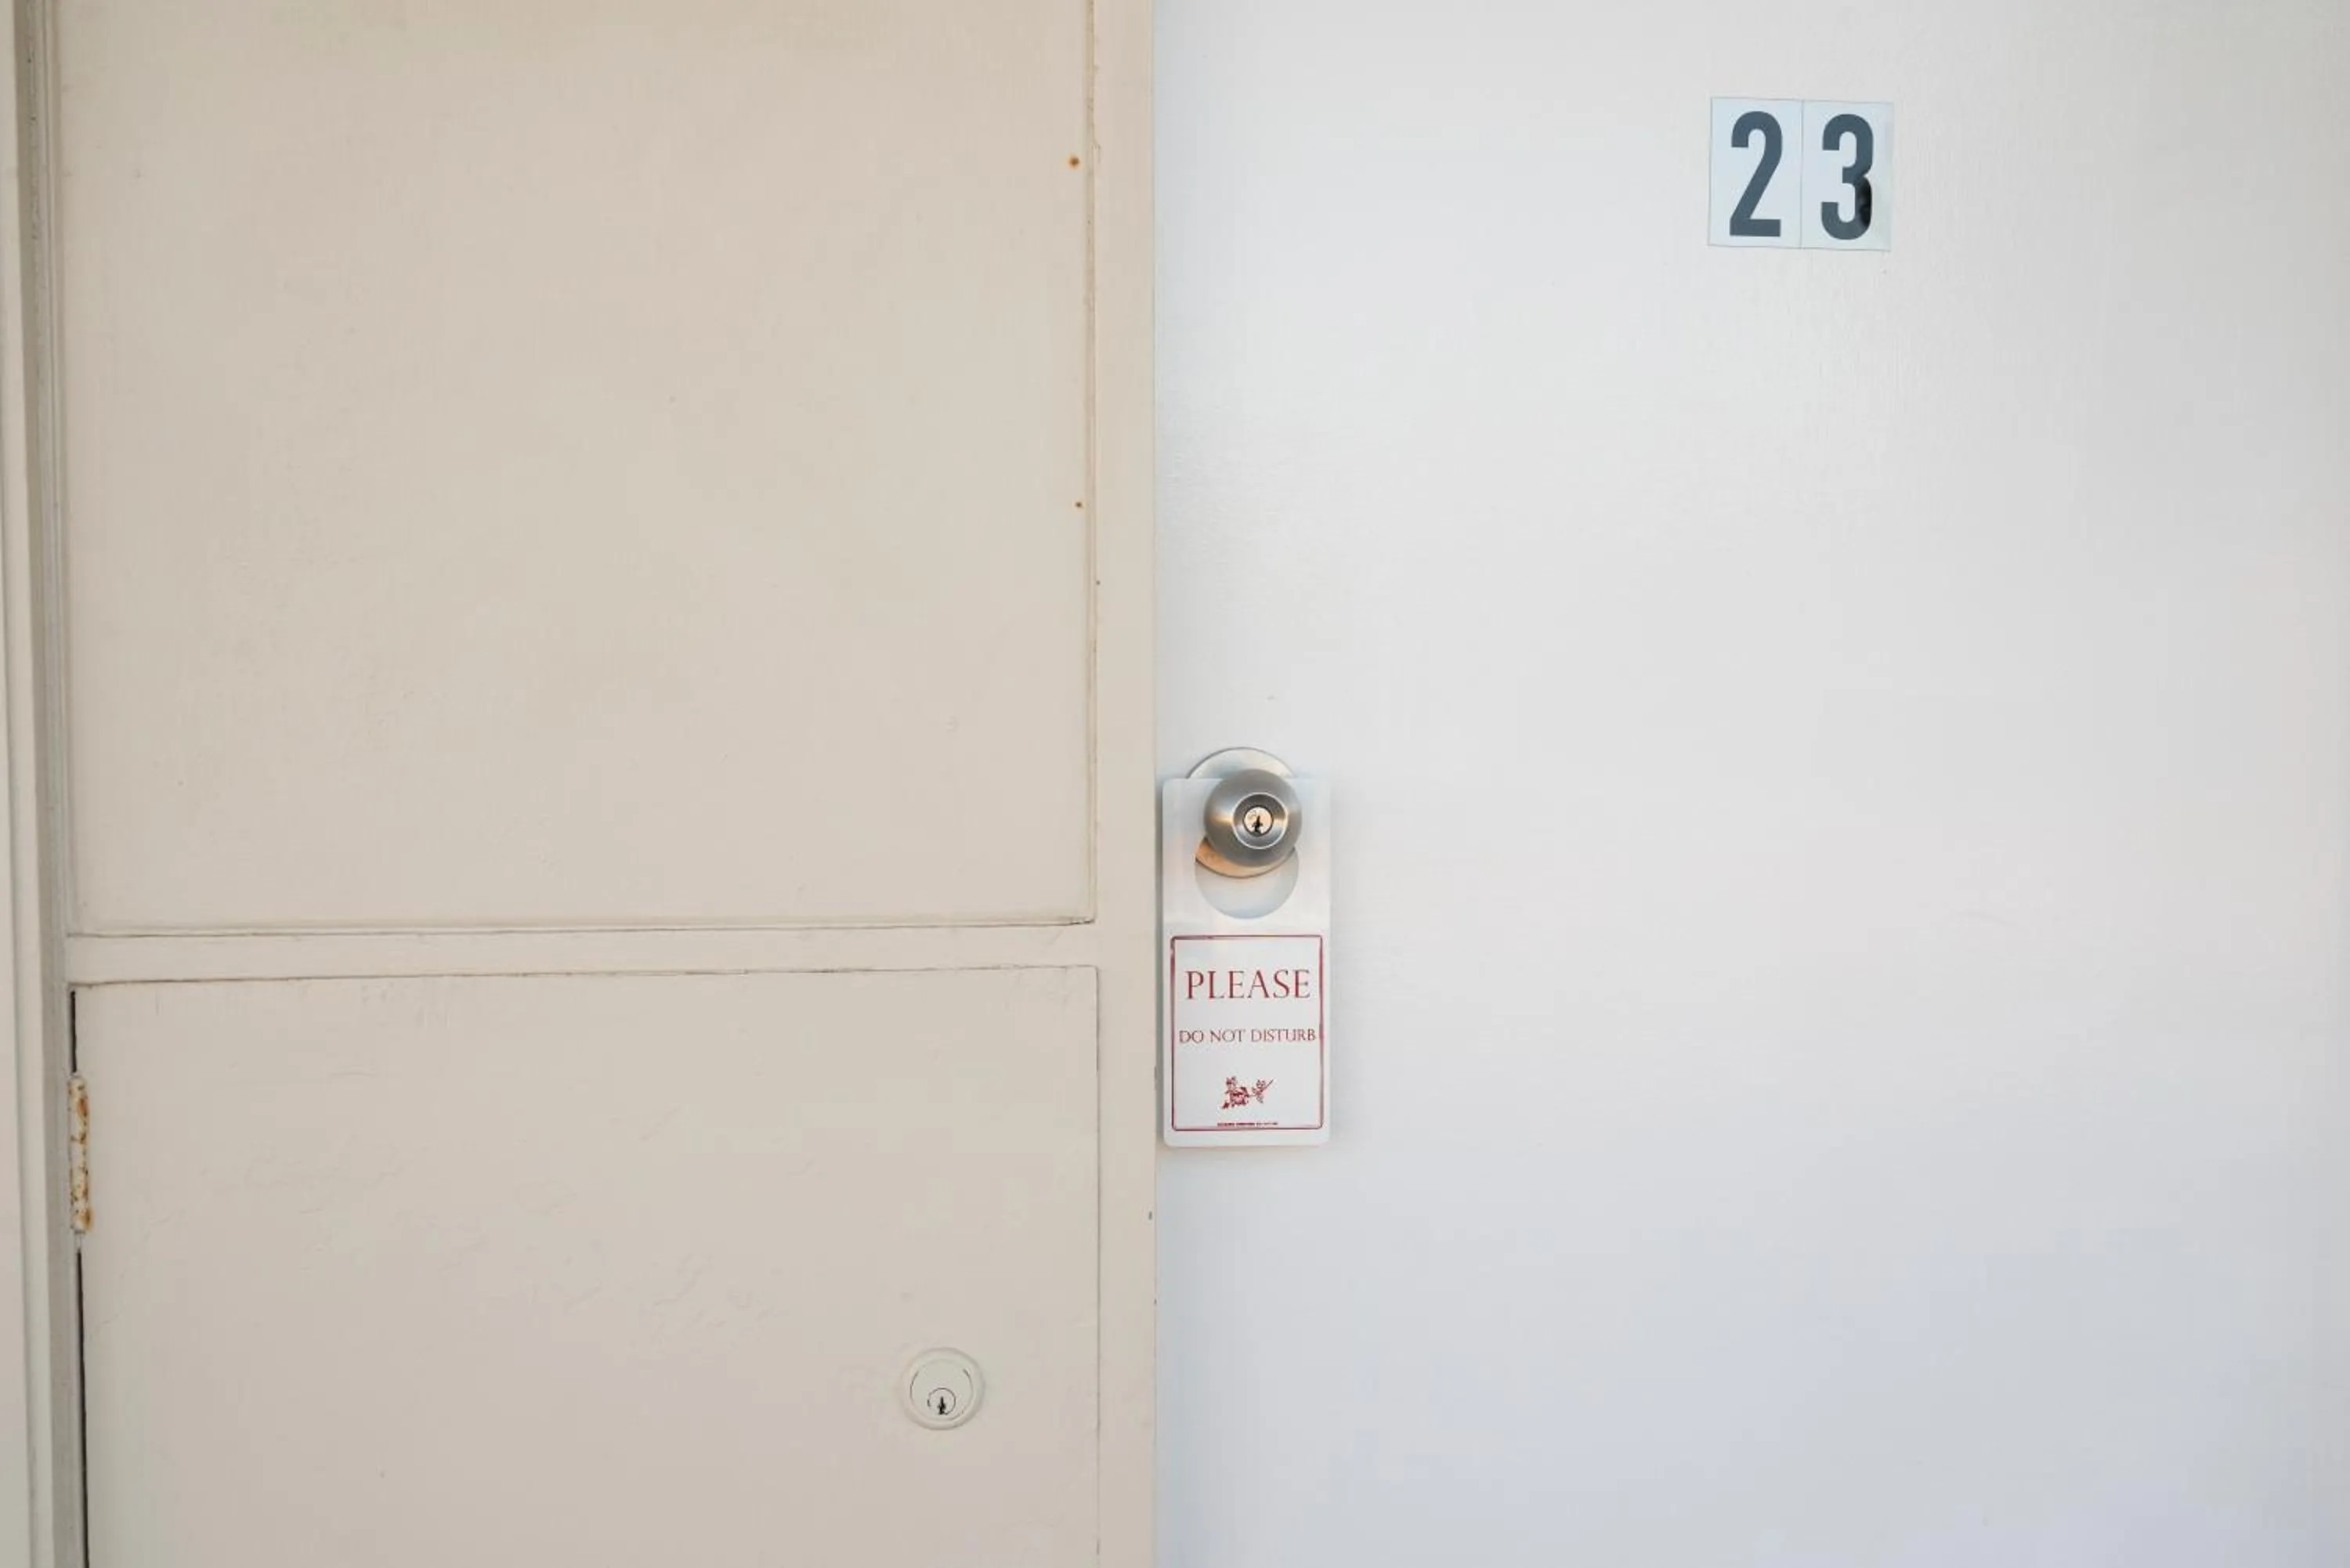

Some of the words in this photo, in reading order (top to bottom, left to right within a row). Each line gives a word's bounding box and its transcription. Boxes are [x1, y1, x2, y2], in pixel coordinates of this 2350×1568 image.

[1729, 110, 1874, 240] 23
[1185, 969, 1311, 999] PLEASE
[1179, 1029, 1204, 1044] DO
[1209, 1029, 1246, 1043] NOT
[1251, 1028, 1317, 1043] DISTURB
